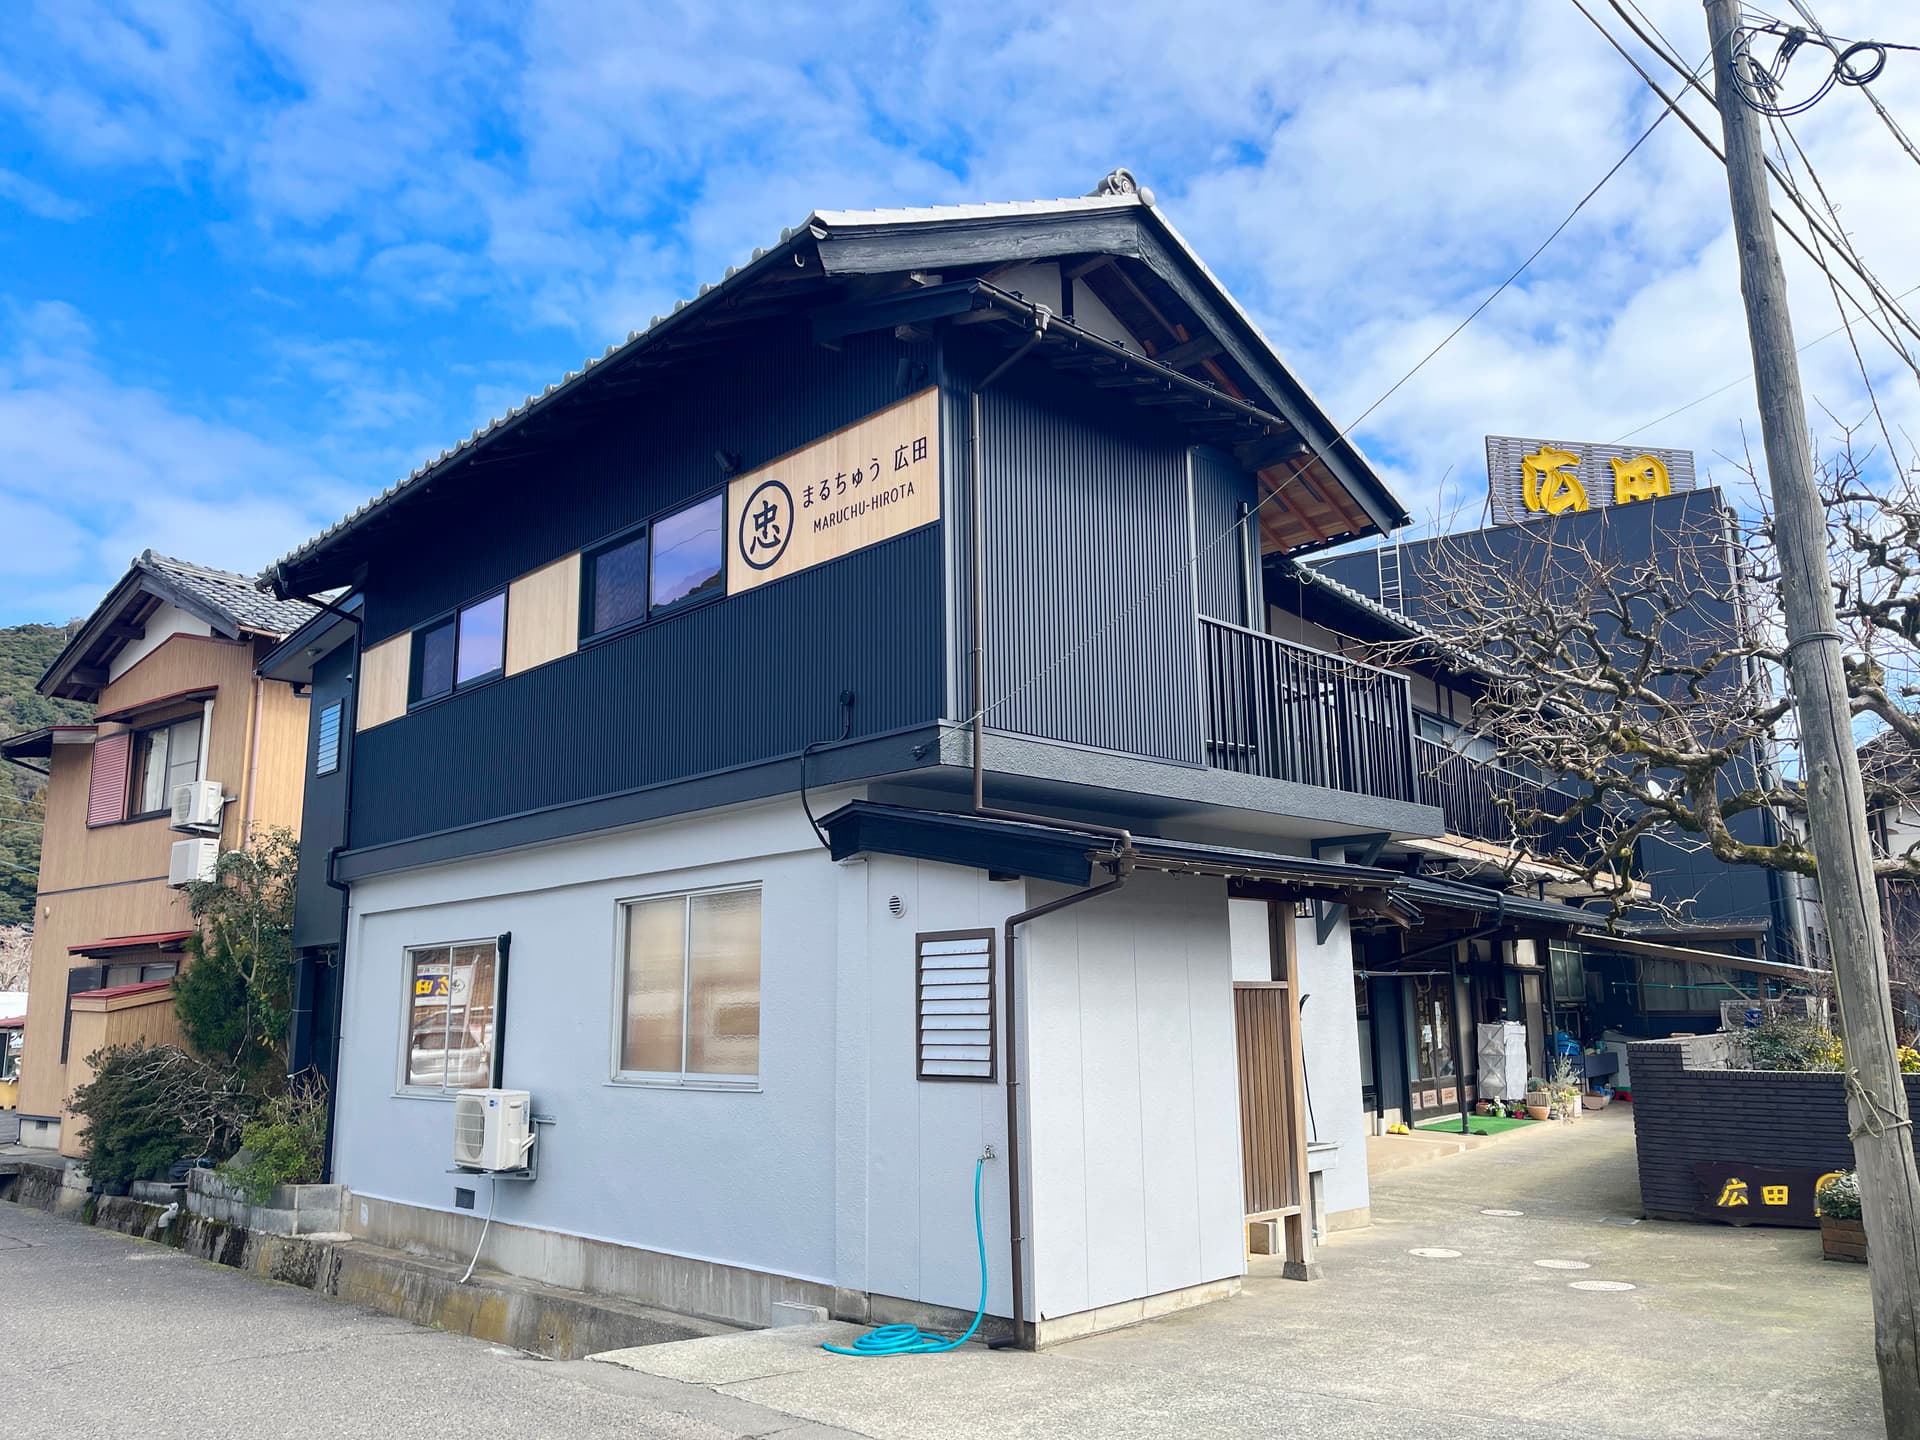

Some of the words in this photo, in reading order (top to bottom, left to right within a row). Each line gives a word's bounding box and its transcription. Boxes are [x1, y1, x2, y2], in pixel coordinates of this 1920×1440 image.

[803, 457, 880, 508] まるちゅう
[894, 436, 927, 472] 広田
[1521, 446, 1670, 515] 広田
[750, 500, 781, 555] 忠
[813, 481, 915, 534] MARUCHU-HIROTA
[1717, 1177, 1789, 1207] 広田
